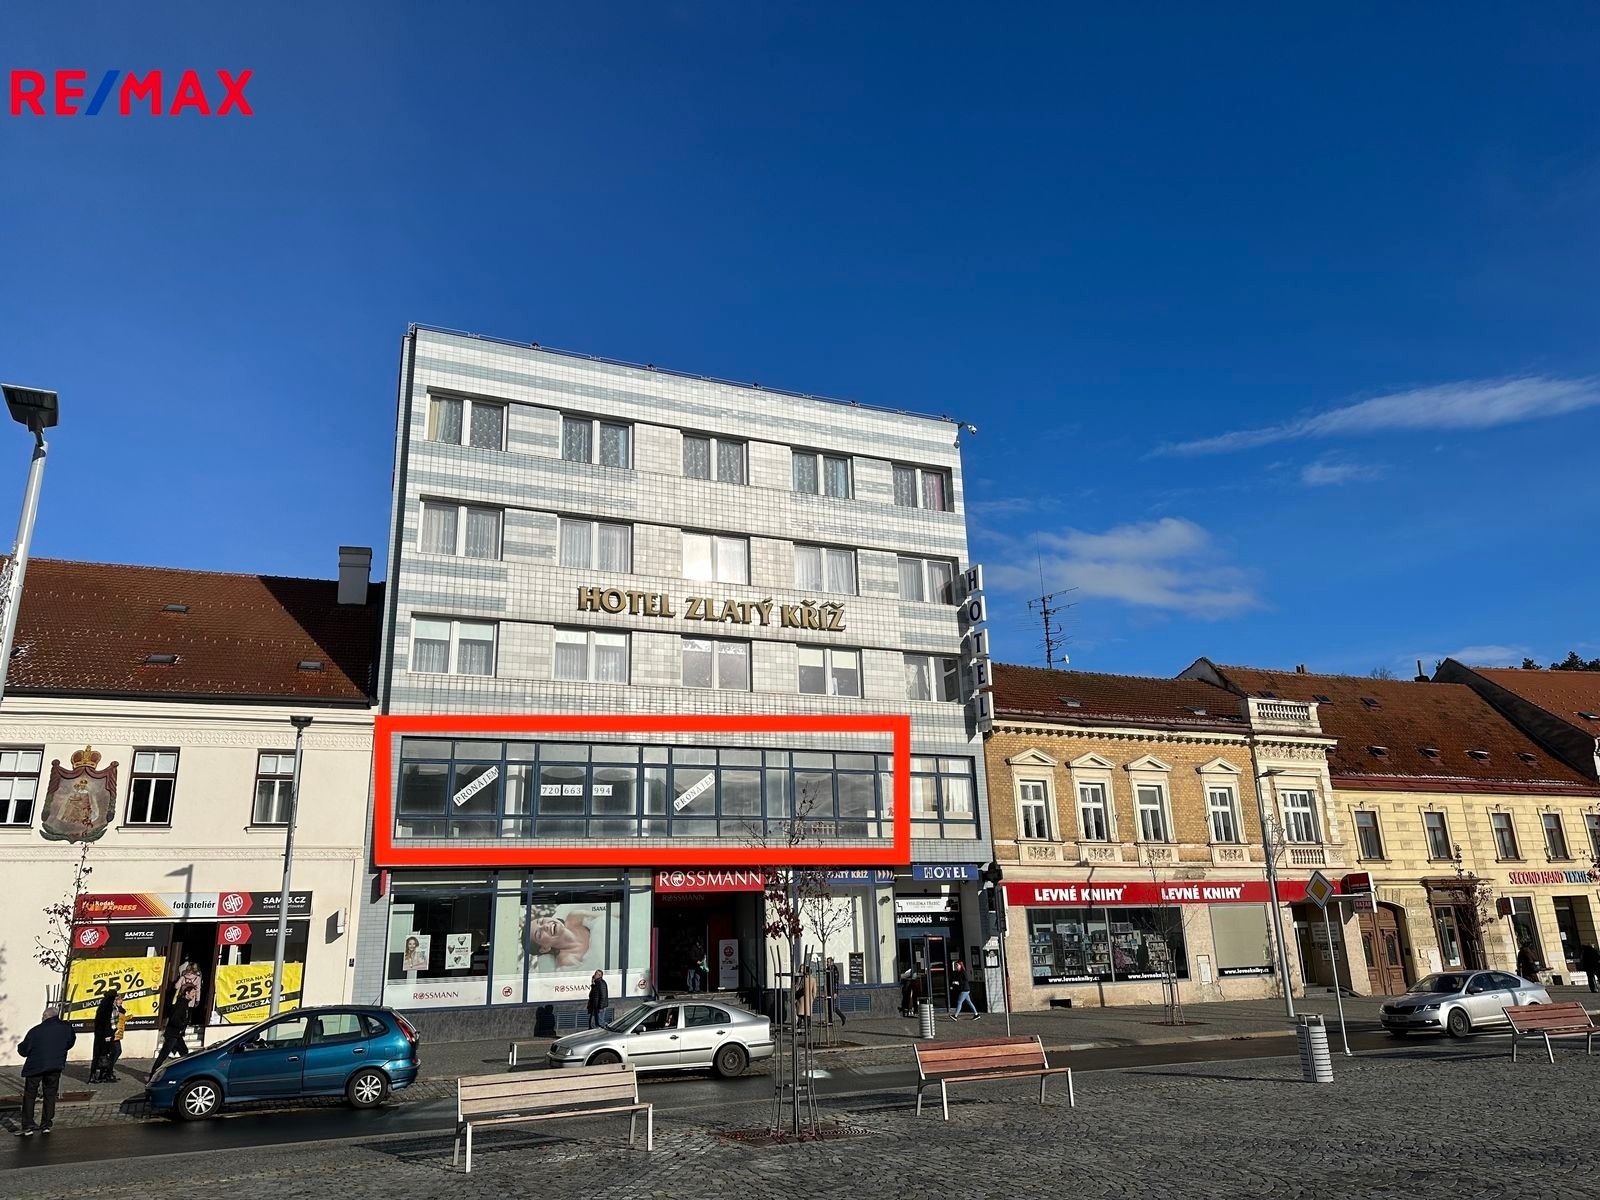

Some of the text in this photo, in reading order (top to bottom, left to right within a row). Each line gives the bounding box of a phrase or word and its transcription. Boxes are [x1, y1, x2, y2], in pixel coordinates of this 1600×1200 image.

[577, 585, 847, 632] HOTEL ZLATÝ KŘÍŽ
[967, 572, 988, 719] HOTEL
[542, 787, 611, 795] 720 663 994
[923, 866, 969, 879] HOTEL
[659, 870, 762, 887] ROSSMANN
[1508, 871, 1540, 885] SECOND
[1541, 871, 1564, 884] HAND
[1034, 885, 1078, 902] LEVNÉ
[1161, 884, 1201, 900] LEVNÉ
[262, 896, 307, 904] SAM3.CZ
[662, 893, 705, 902] ROSSMANN
[173, 900, 216, 910] fotoateliér
[896, 916, 933, 924] METROPOLIS
[93, 972, 113, 980] EXTRA
[235, 977, 255, 985] EXTRA
[554, 984, 591, 993] ROSSMAN
[123, 990, 147, 1000] ÁSOB!
[412, 991, 459, 1000] ROSSMANN
[225, 995, 286, 1013] LIKVIDACE ZÁB!
